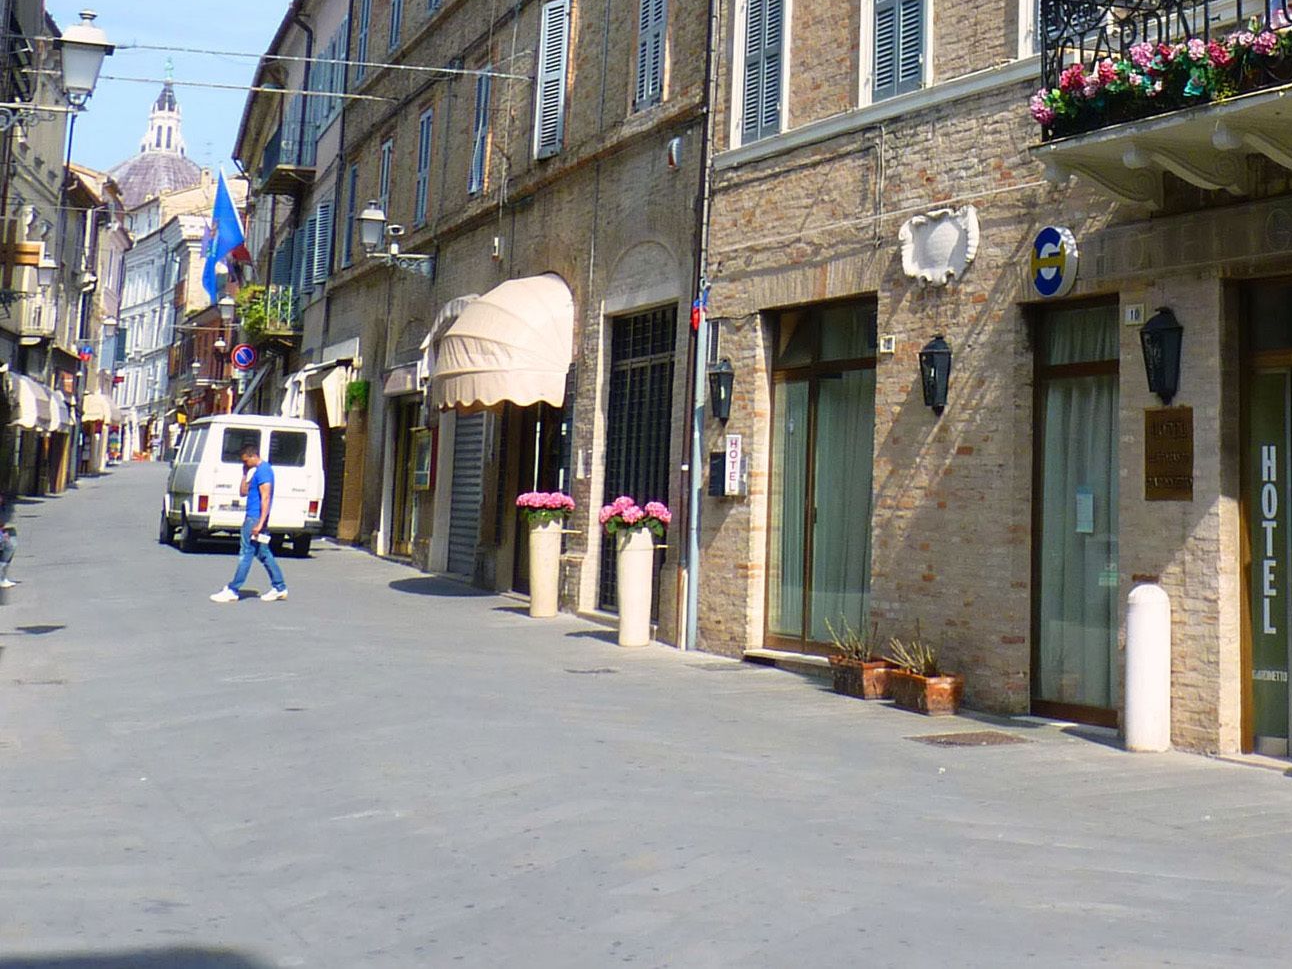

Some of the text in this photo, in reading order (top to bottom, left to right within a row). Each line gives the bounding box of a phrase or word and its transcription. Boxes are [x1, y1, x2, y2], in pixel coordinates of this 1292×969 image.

[1130, 307, 1140, 320] 10
[729, 439, 738, 492] HOTEL
[1261, 445, 1278, 634] HOTEL
